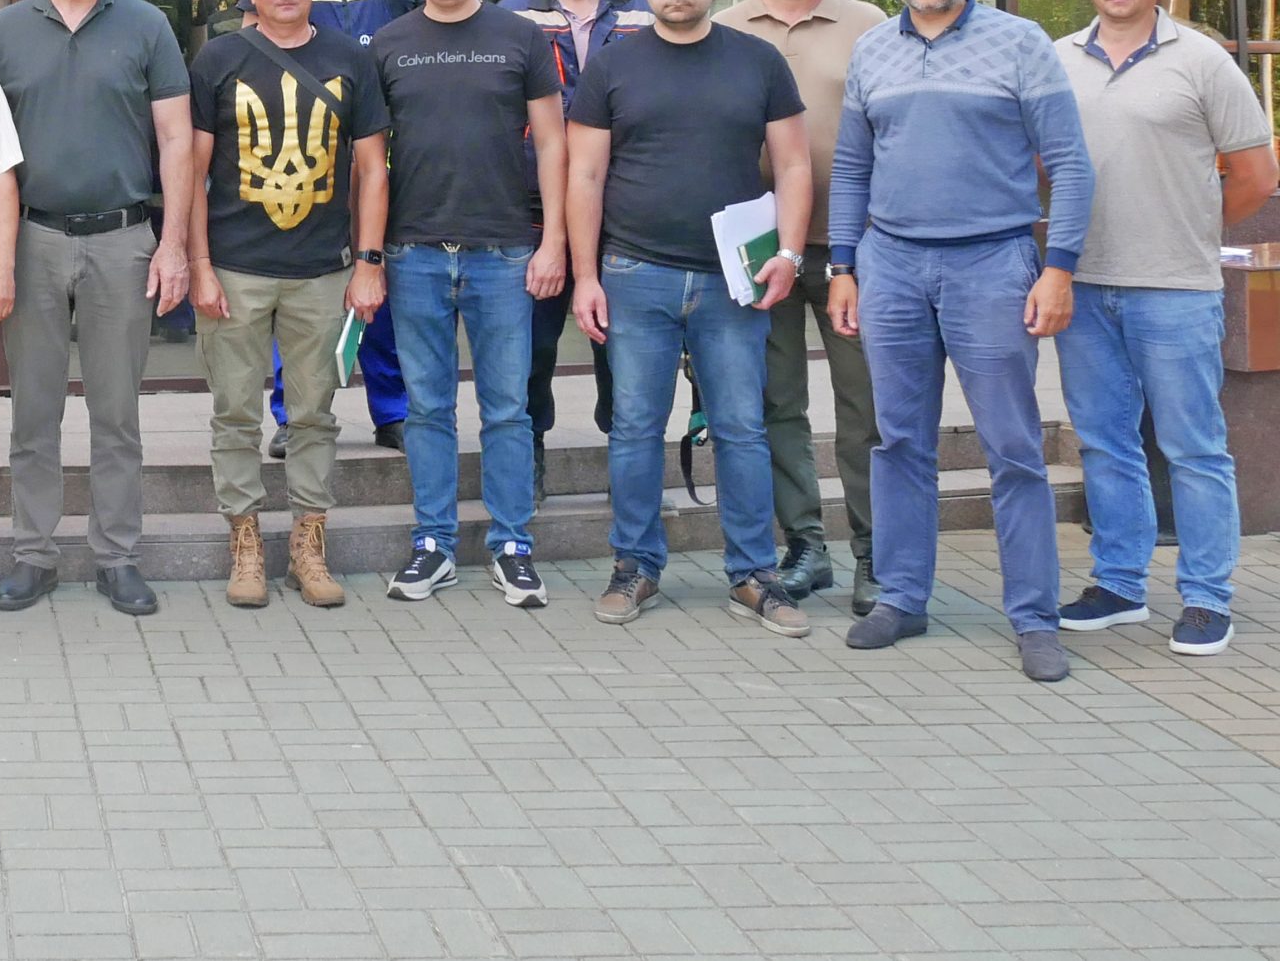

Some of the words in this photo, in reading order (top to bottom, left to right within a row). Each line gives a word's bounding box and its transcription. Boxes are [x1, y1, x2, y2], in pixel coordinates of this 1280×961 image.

[397, 53, 435, 68] Calvin
[436, 50, 466, 64] Klein
[467, 50, 506, 64] Jeans
